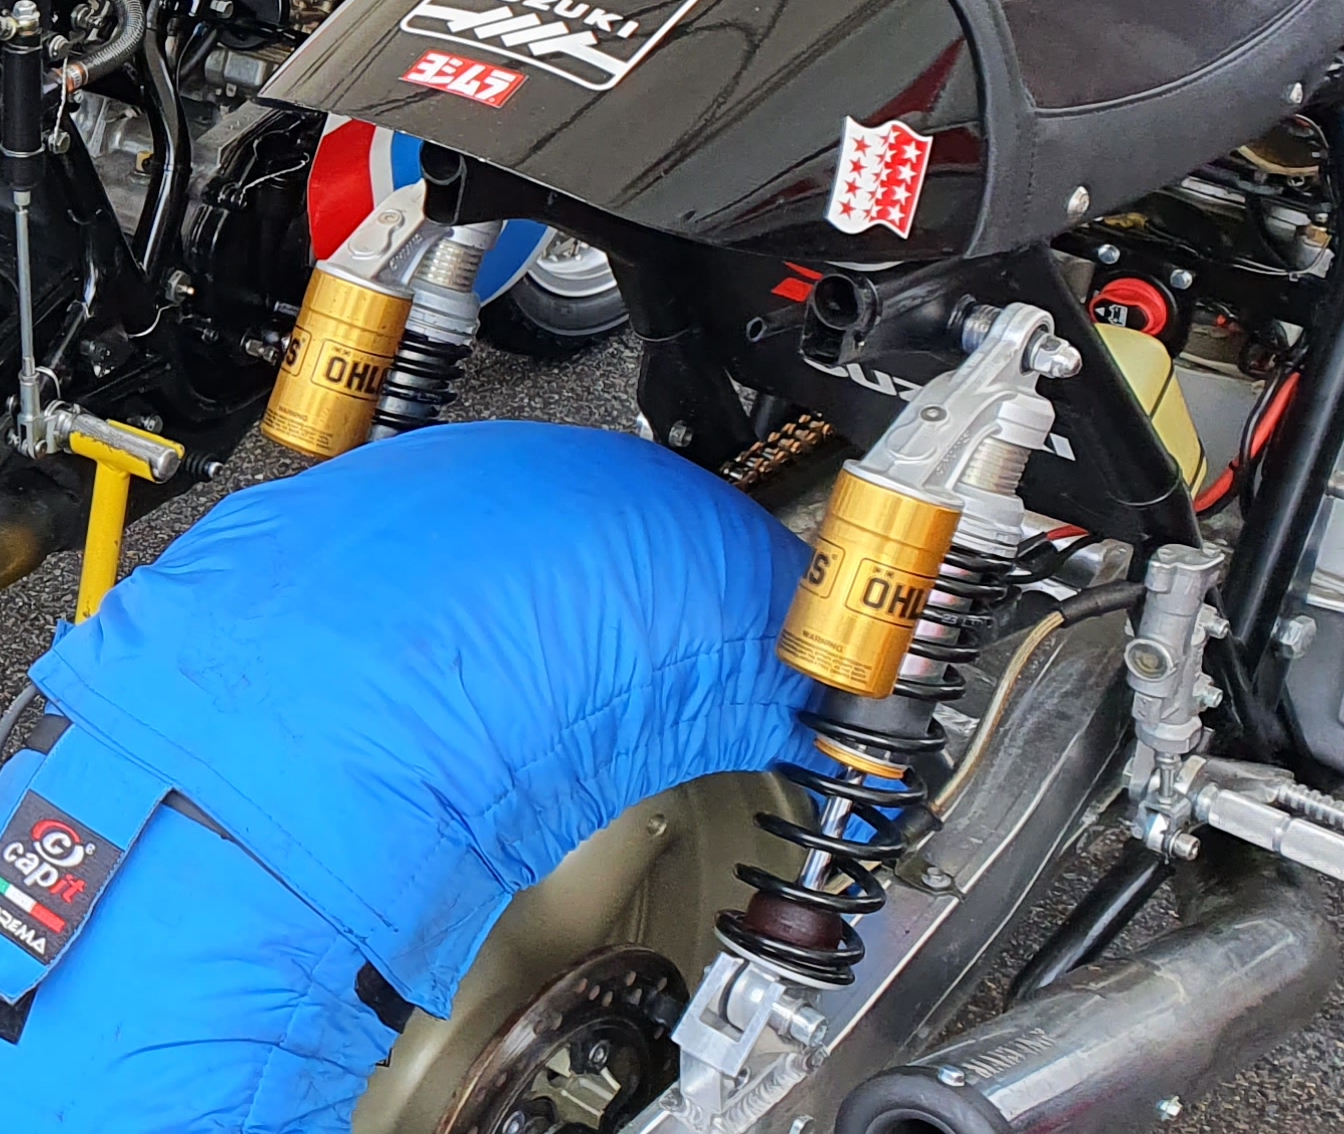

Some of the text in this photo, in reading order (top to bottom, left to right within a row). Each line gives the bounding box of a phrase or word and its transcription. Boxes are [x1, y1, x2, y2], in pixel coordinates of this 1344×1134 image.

[407, 53, 517, 102] ヨシムラ
[801, 629, 843, 654] WARNING
[2, 842, 87, 905] capit
